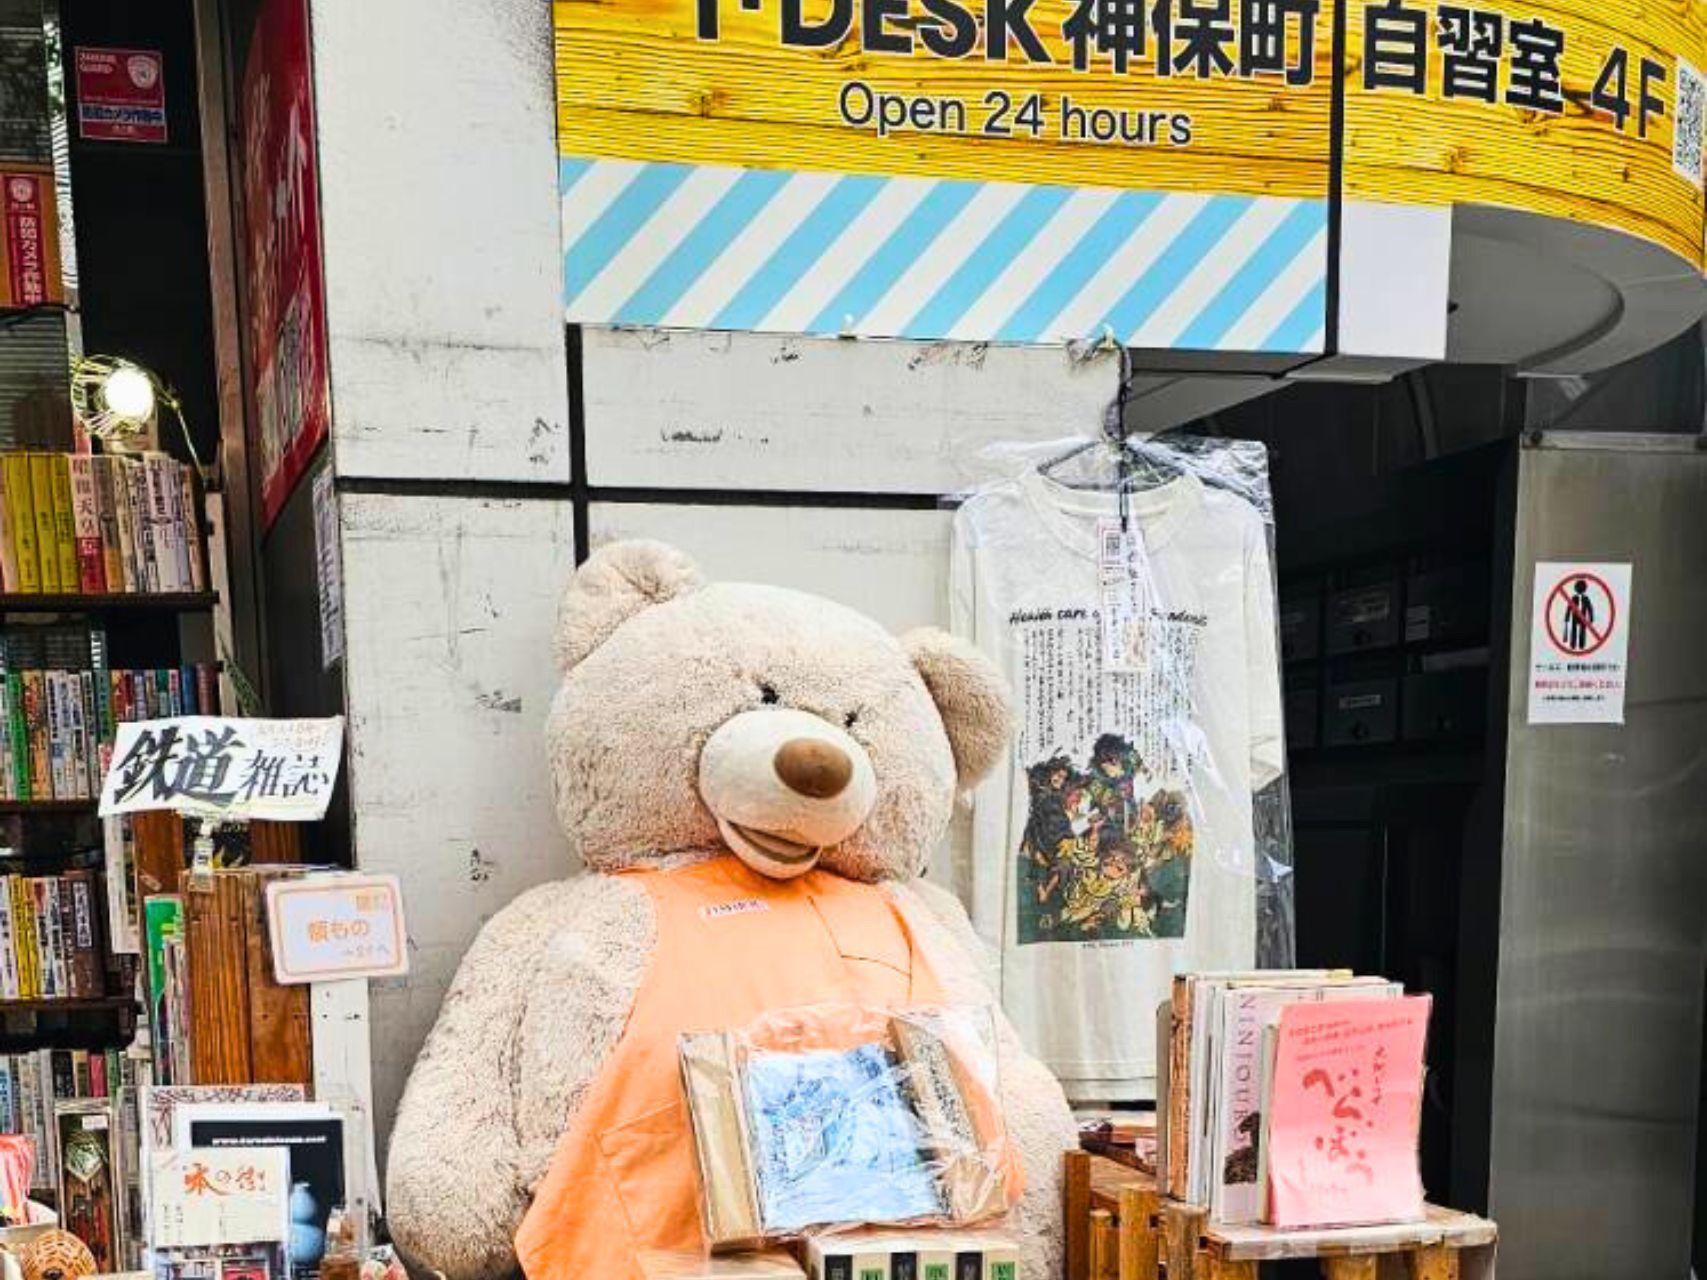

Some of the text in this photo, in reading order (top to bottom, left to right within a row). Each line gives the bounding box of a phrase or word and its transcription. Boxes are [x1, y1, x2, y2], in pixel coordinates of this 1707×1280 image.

[1062, 0, 1320, 86] 神保町
[1364, 0, 1666, 138] 自習室 4F
[840, 82, 1192, 143] Open 24 hours
[113, 724, 330, 805] 鉄道雑誌
